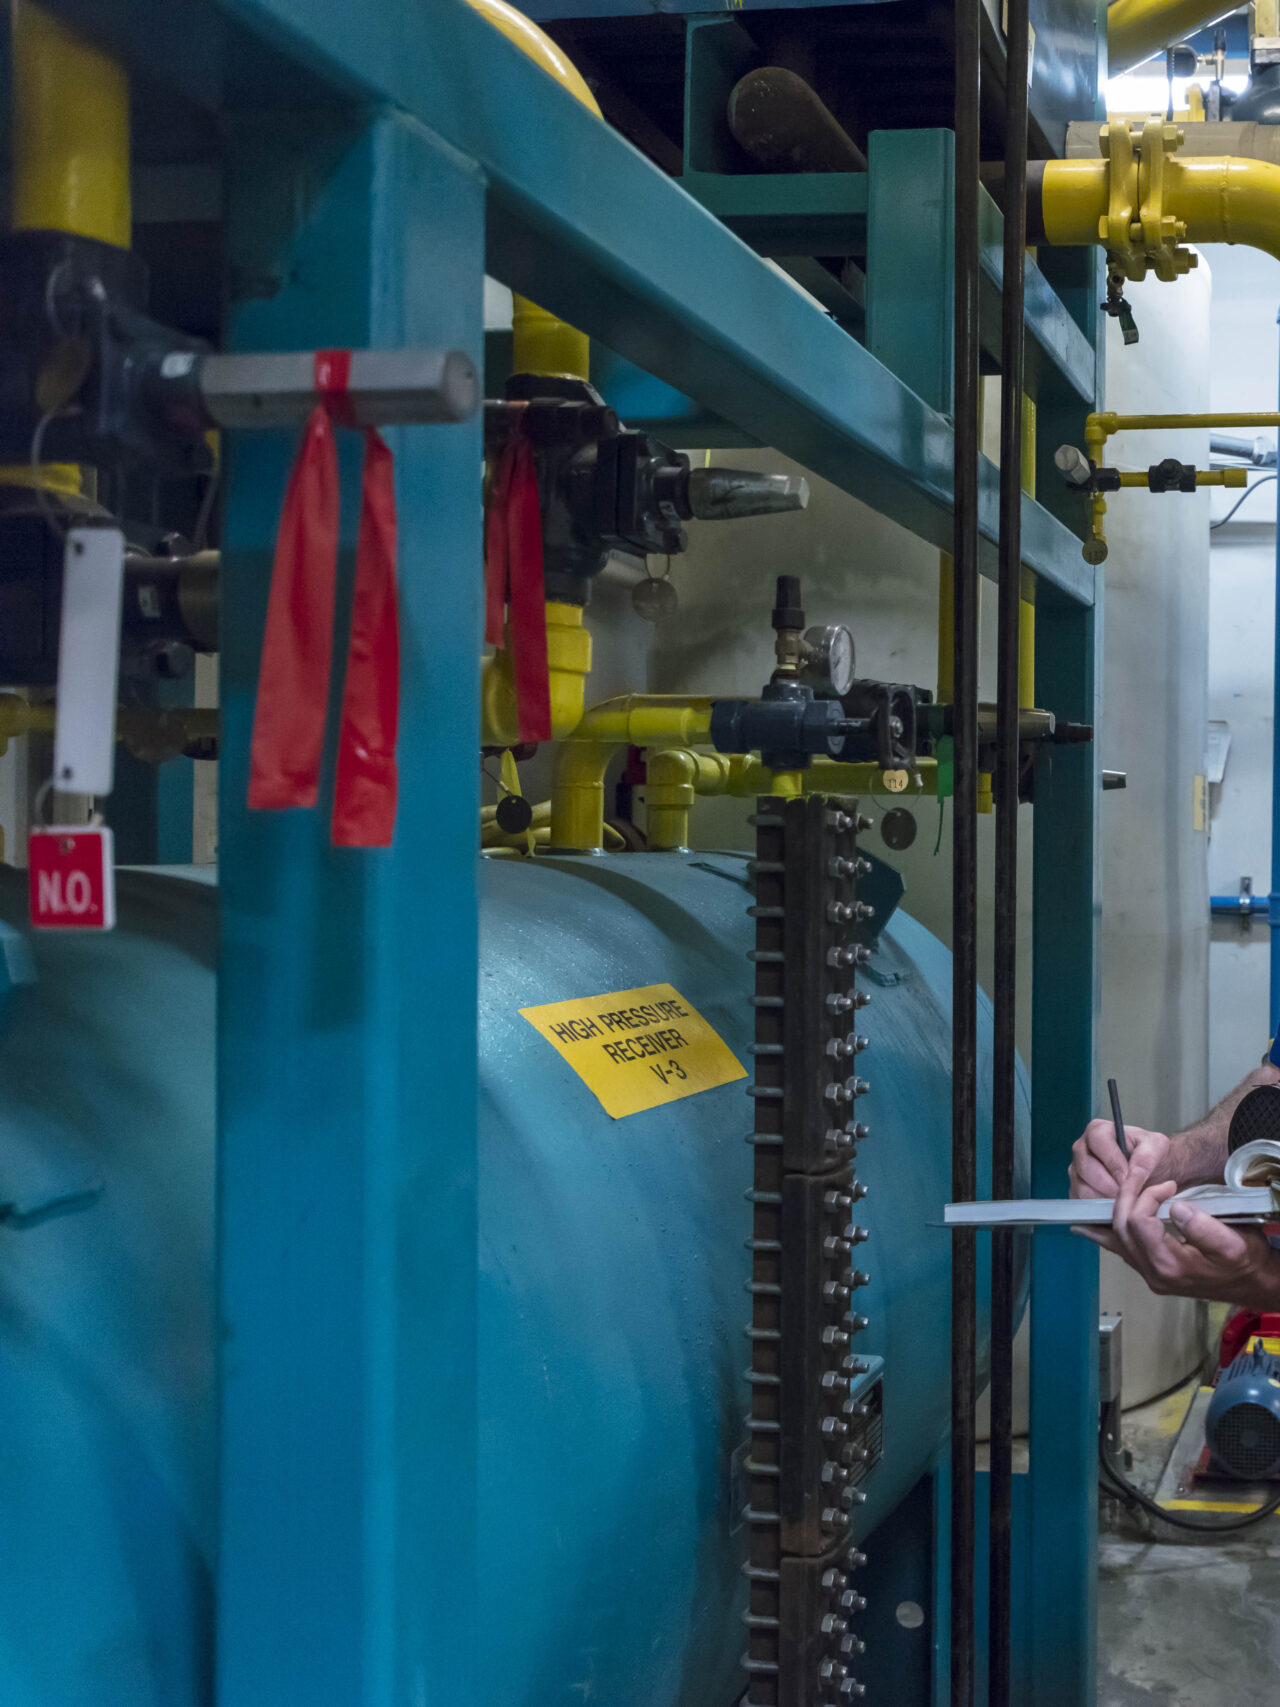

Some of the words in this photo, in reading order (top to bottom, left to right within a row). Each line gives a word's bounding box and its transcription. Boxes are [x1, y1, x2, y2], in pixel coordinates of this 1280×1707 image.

[38, 869, 98, 914] N.O.
[549, 1016, 604, 1044] HIGH
[597, 1000, 690, 1033] PRESSURE
[602, 1028, 690, 1064] RECEIVER
[649, 1060, 688, 1085] V-3
